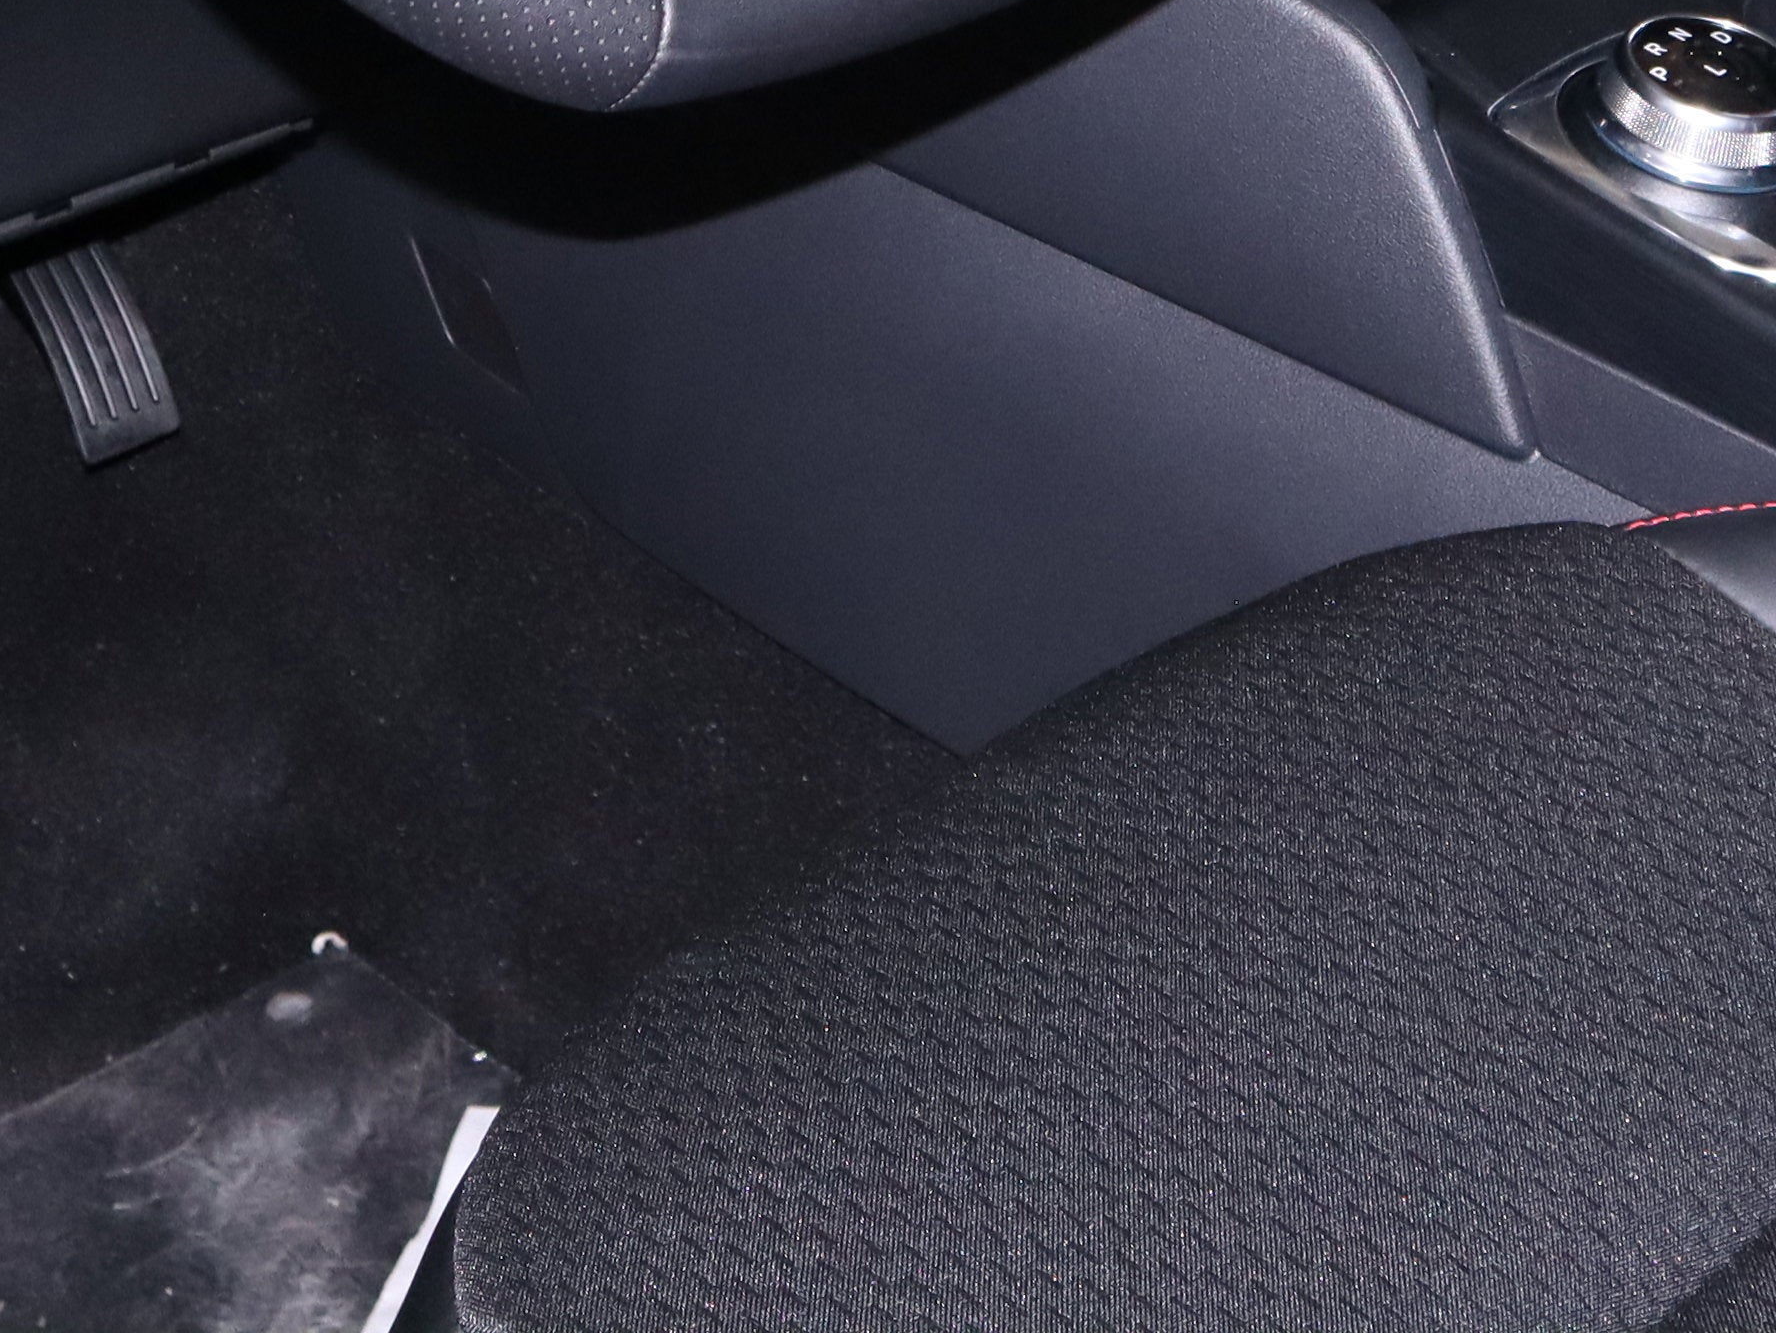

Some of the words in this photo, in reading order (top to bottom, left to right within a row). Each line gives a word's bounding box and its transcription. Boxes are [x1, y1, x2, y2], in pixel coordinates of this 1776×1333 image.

[1668, 27, 1692, 41] N
[1710, 31, 1732, 44] D
[1644, 43, 1668, 56] R
[1649, 66, 1667, 81] P
[1704, 64, 1727, 76] L
